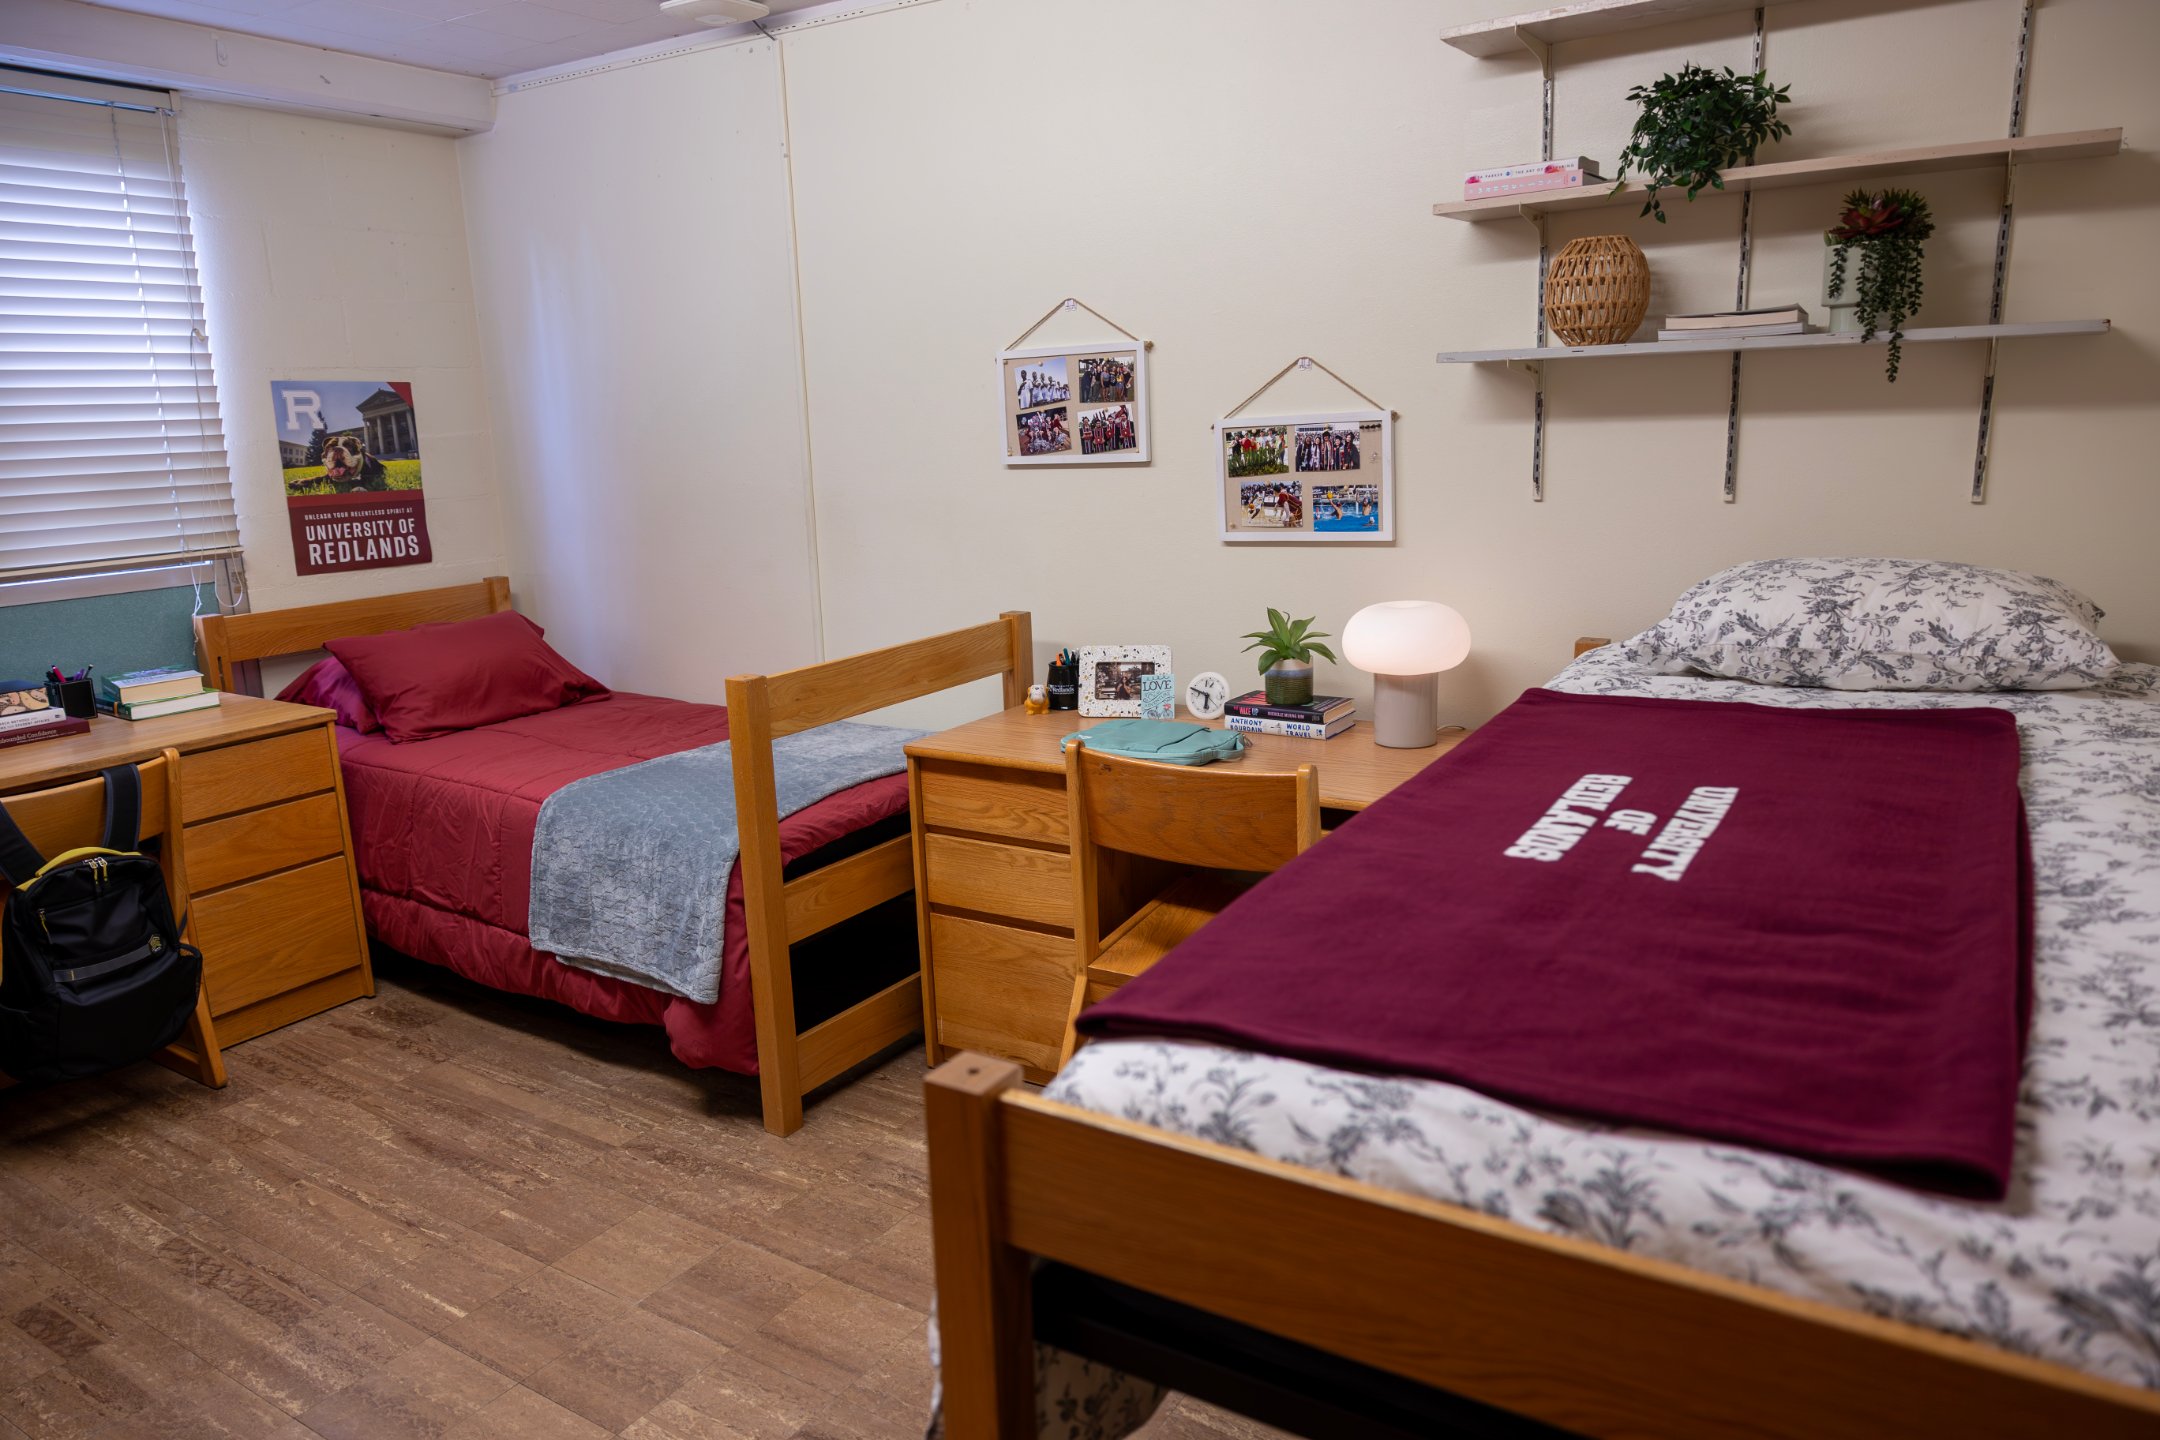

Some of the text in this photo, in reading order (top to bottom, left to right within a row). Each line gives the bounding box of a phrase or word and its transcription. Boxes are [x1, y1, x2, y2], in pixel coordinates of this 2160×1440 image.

[281, 389, 324, 430] R
[304, 513, 332, 521] UNLEASH
[350, 509, 385, 517] RELENTLESS
[306, 518, 415, 542] UNIVERSITY OF
[308, 534, 420, 566] REDLANDS
[1142, 680, 1172, 691] LOVE
[27, 729, 57, 738] Confidence
[1230, 725, 1262, 733] BOURDAIN
[1231, 718, 1262, 726] ANTHONY
[1503, 774, 1633, 862] REDLANDS
[1603, 809, 1658, 836] OF
[1631, 786, 1740, 882] UNIVERSITY
